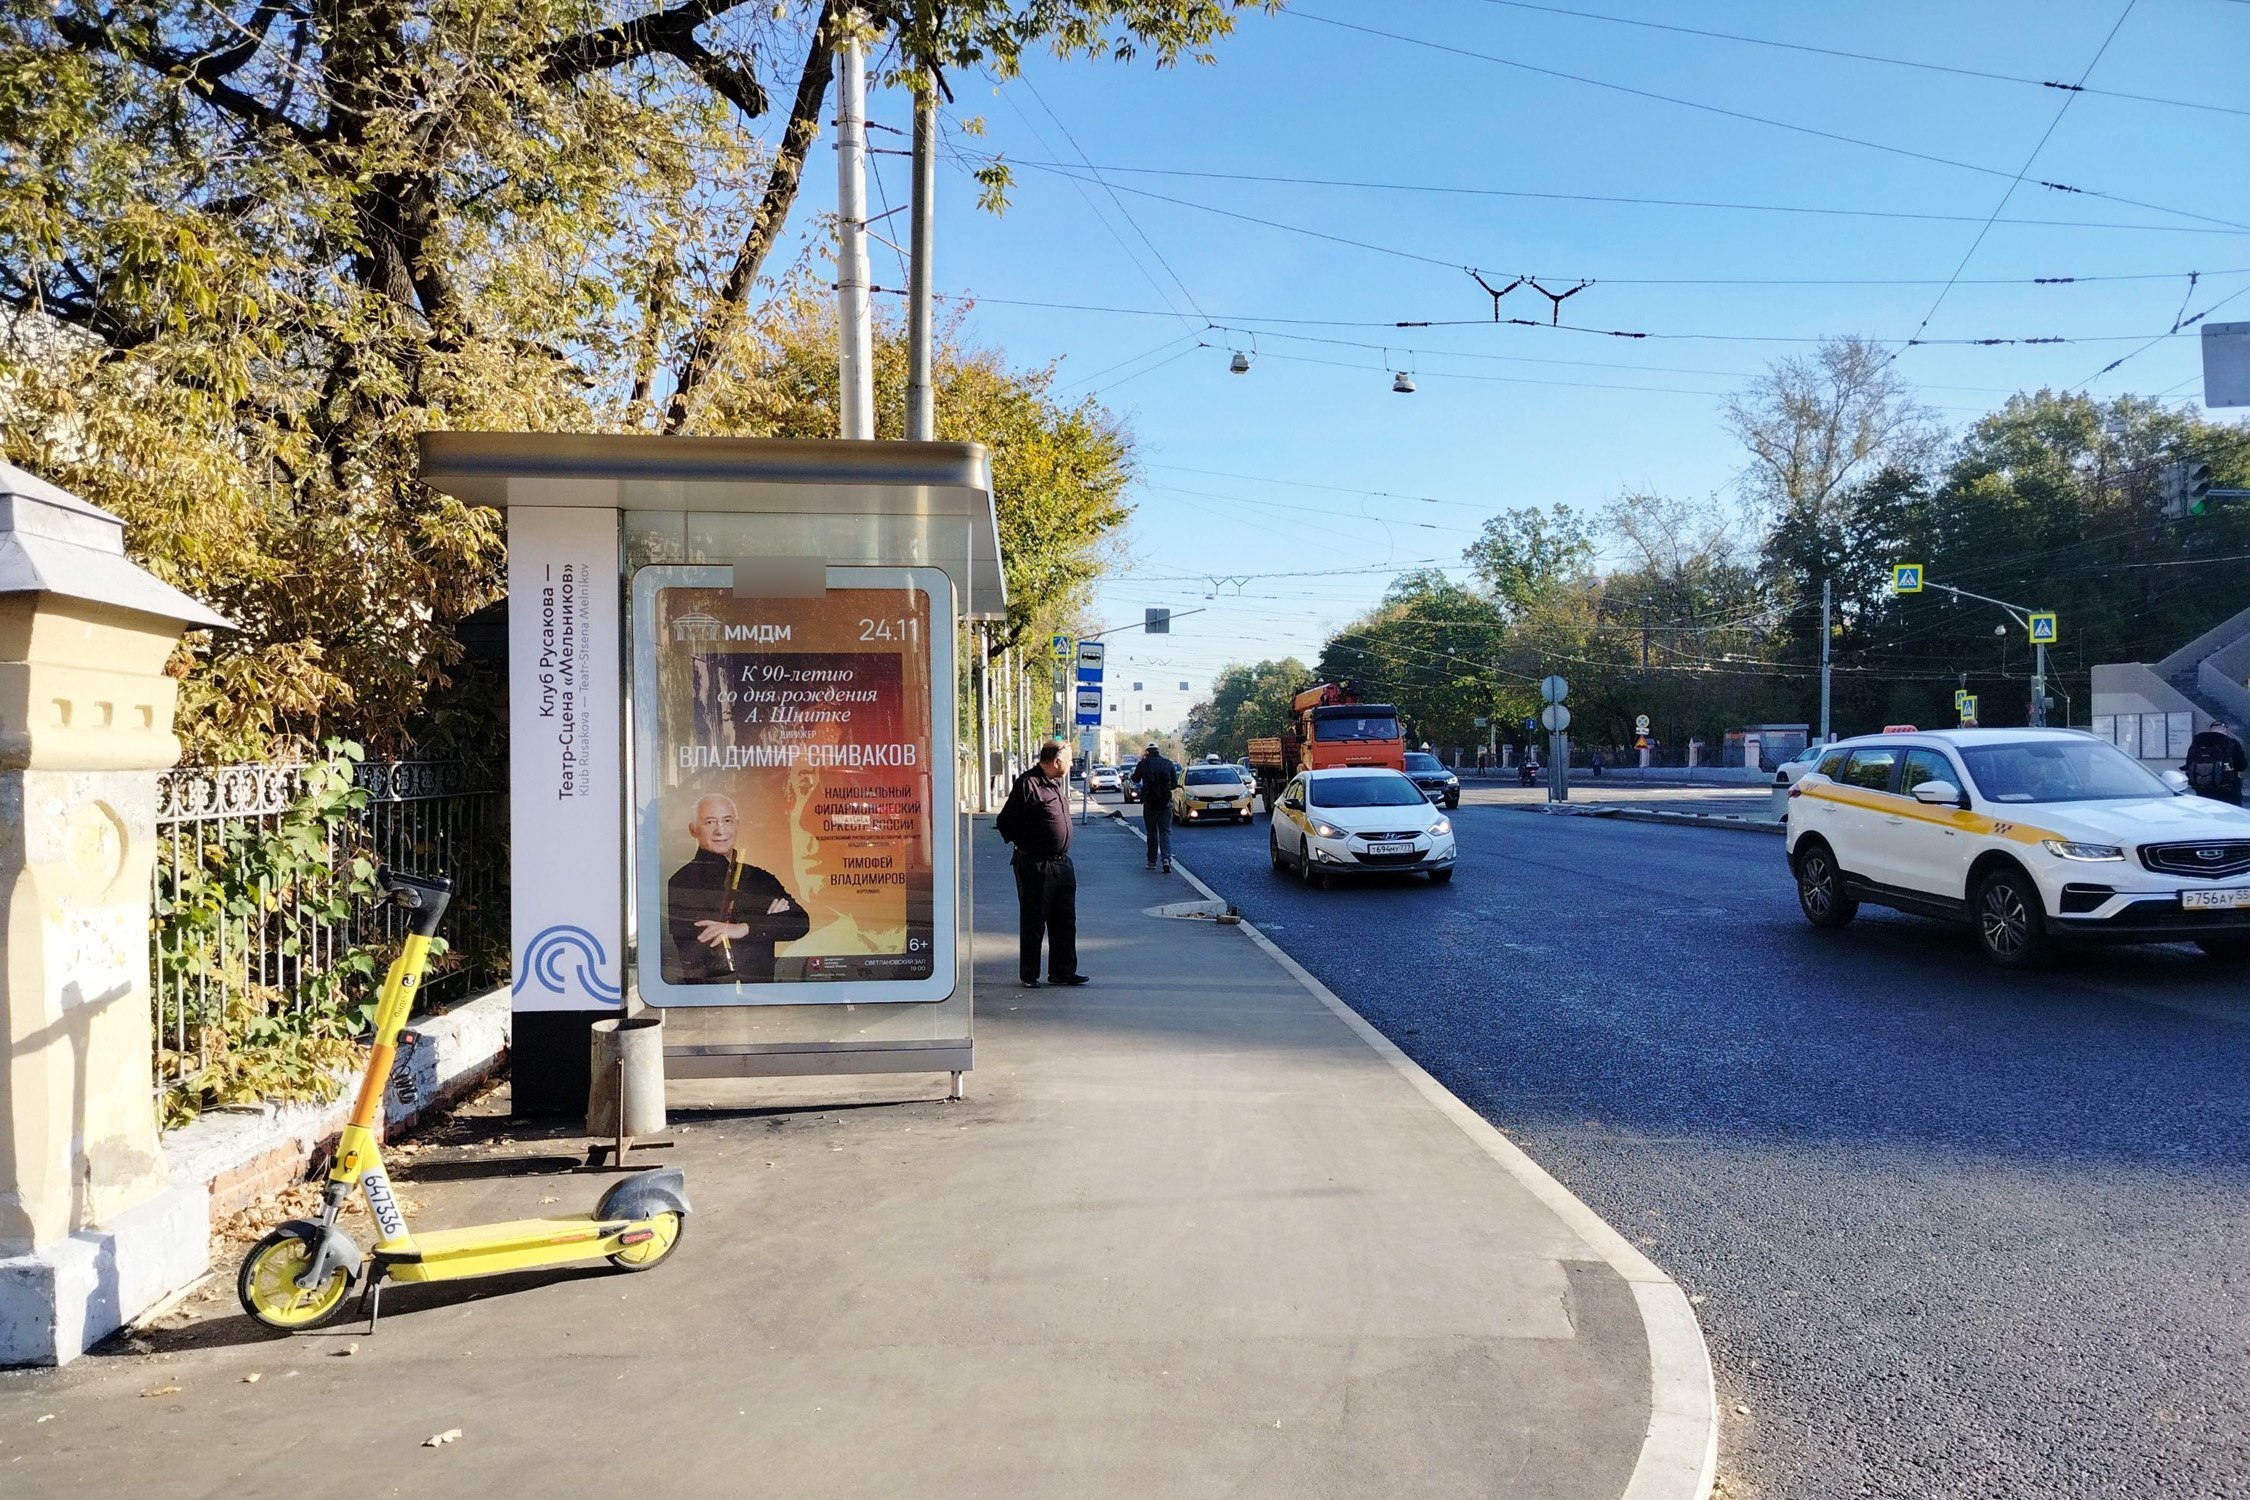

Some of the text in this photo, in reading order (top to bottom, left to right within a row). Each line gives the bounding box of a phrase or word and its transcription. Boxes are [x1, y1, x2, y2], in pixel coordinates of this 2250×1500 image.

[578, 563, 590, 620] Melnikov
[539, 588, 558, 668] Русакова
[724, 625, 792, 643] ММДМ
[858, 618, 919, 642] 24.11
[578, 622, 590, 693] Teatr-Stsena
[558, 564, 577, 801] Театр-Сцена «Мельников»
[741, 665, 854, 682] К 90-летию
[539, 674, 558, 717] Клуб
[717, 686, 878, 706] со дня рождения
[744, 706, 851, 723] А. Шнитке
[579, 712, 590, 766] Rusakova
[679, 743, 916, 770] ВЛАДИМИР СПИВАКОВ
[579, 769, 590, 797] Klub
[824, 784, 912, 800] НАЦИОНАЛЬНЫЙ
[814, 801, 922, 815] ФИЛАРМОНИЧЕСКИЙ
[843, 855, 893, 869] ТИМОФЕЙ
[830, 872, 906, 886] ВЛАДИМИРОВ
[909, 938, 928, 951] 6+
[364, 1175, 404, 1235] 647336
